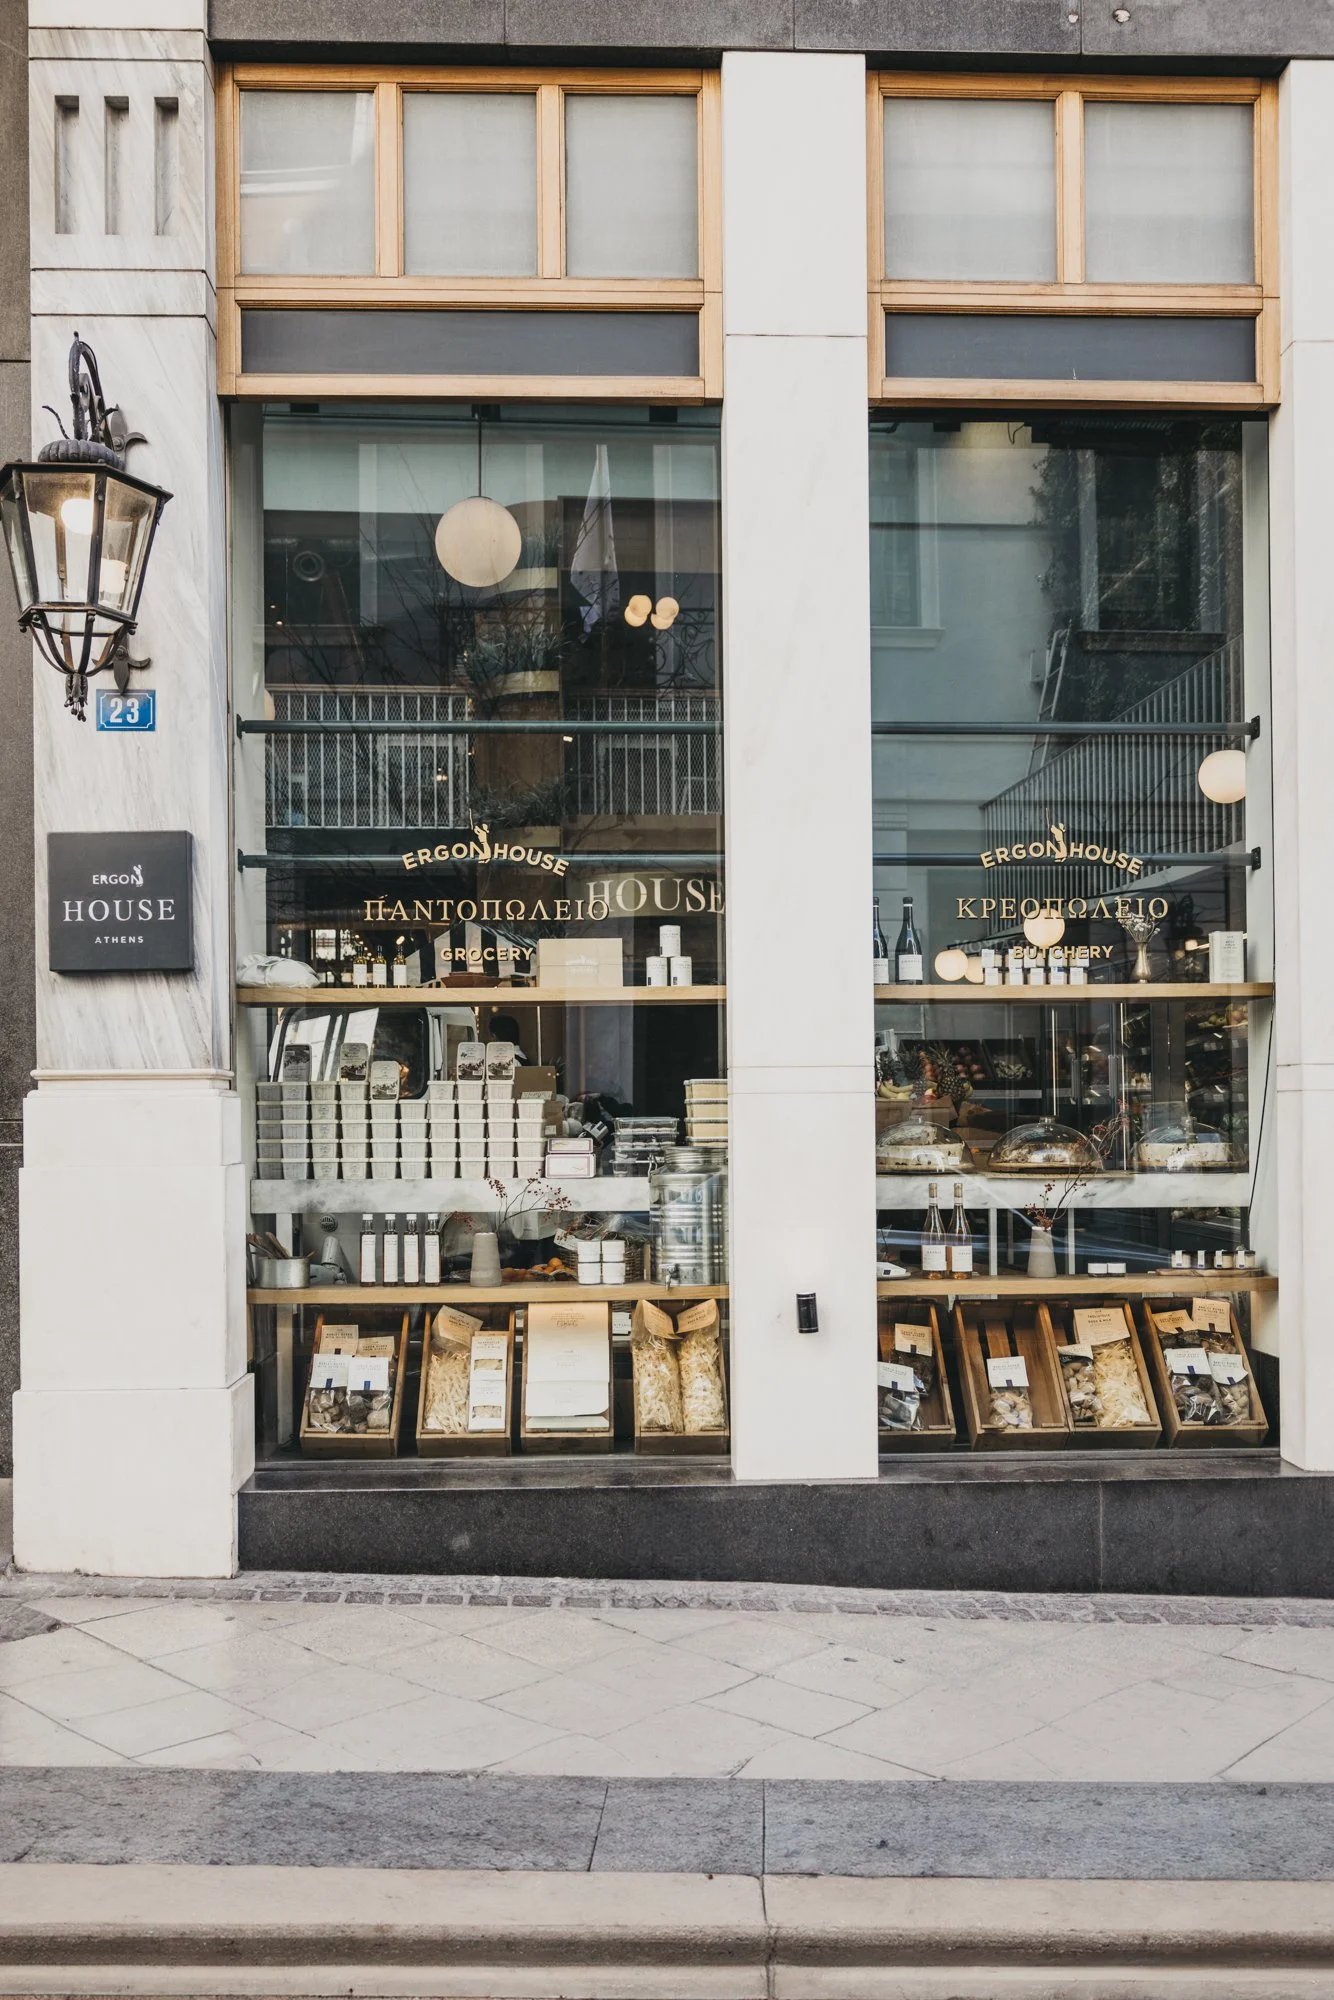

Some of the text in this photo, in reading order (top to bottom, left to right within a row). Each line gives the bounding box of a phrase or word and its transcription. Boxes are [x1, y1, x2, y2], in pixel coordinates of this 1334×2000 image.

[110, 697, 139, 724] 23
[401, 840, 570, 877] ERGON HOUSE
[979, 839, 1144, 875] ERGON HOUSE
[92, 874, 144, 886] ERGON
[586, 877, 726, 914] HOUSE
[62, 898, 176, 922] HOUSE
[363, 898, 610, 922] ΠΑΝΤΟΠΩΛΕΙΟ
[956, 897, 1169, 920] ΚΡΕΟΠΩΛΕΙΟ
[94, 936, 144, 944] ATHENS
[1012, 944, 1114, 960] BUTCHERY
[440, 947, 533, 963] GROCERY
